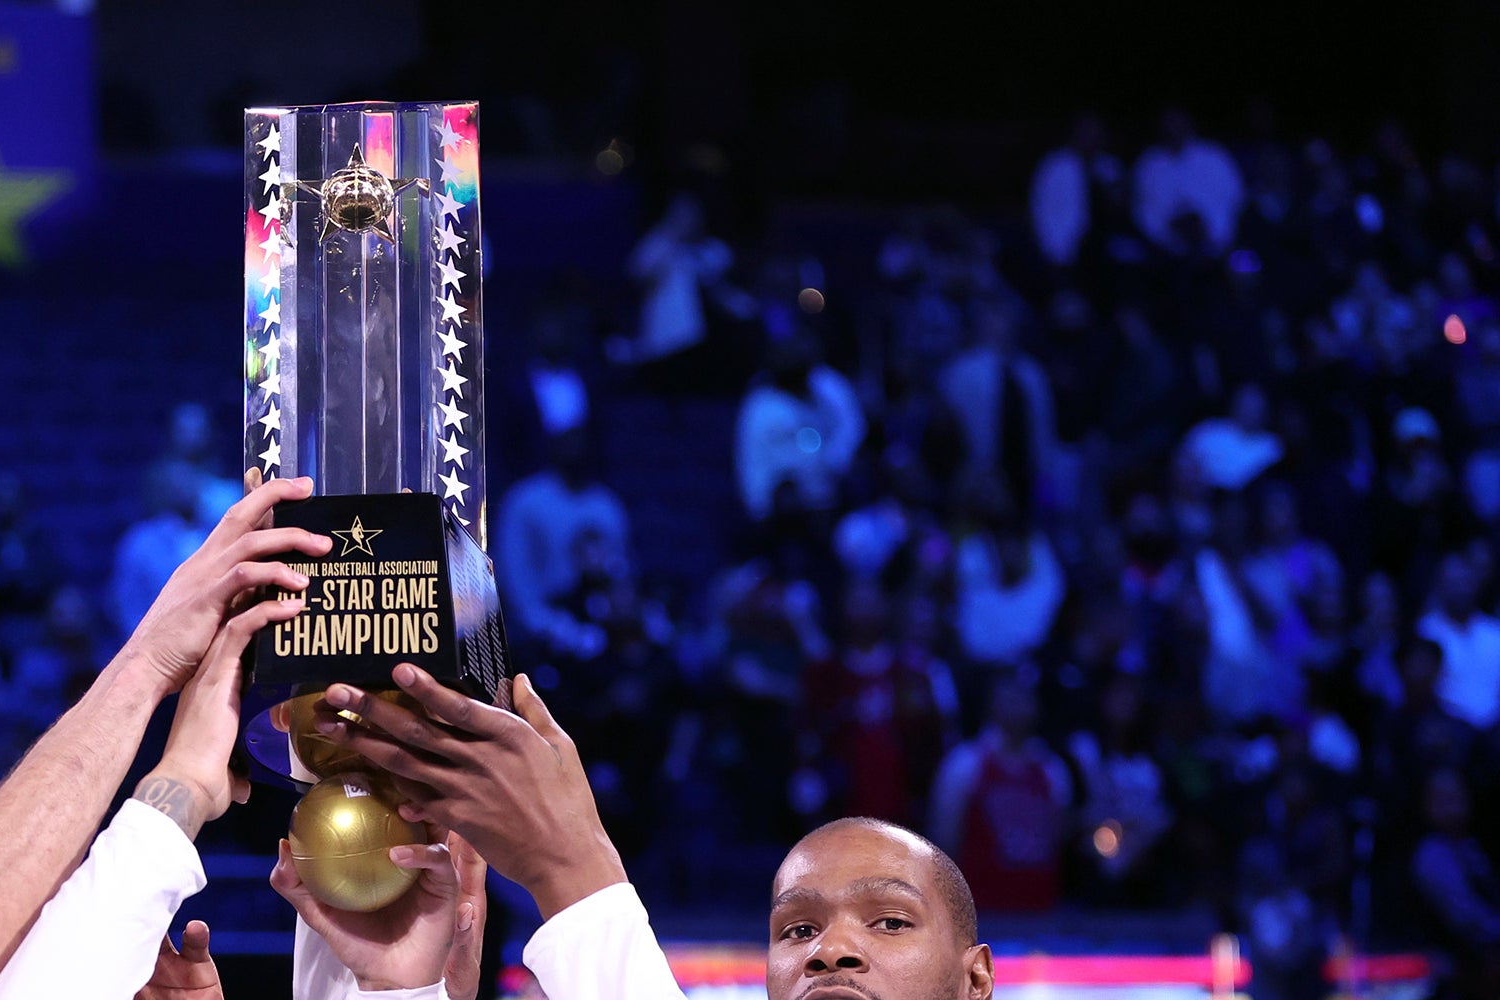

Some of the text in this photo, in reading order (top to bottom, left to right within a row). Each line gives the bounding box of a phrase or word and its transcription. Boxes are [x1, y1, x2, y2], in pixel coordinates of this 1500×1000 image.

[321, 562, 376, 577] BASKETBALL
[378, 560, 438, 576] ASSOCIATION
[277, 577, 439, 612] L-STAR GAME
[274, 612, 439, 657] CHAMPIONS
